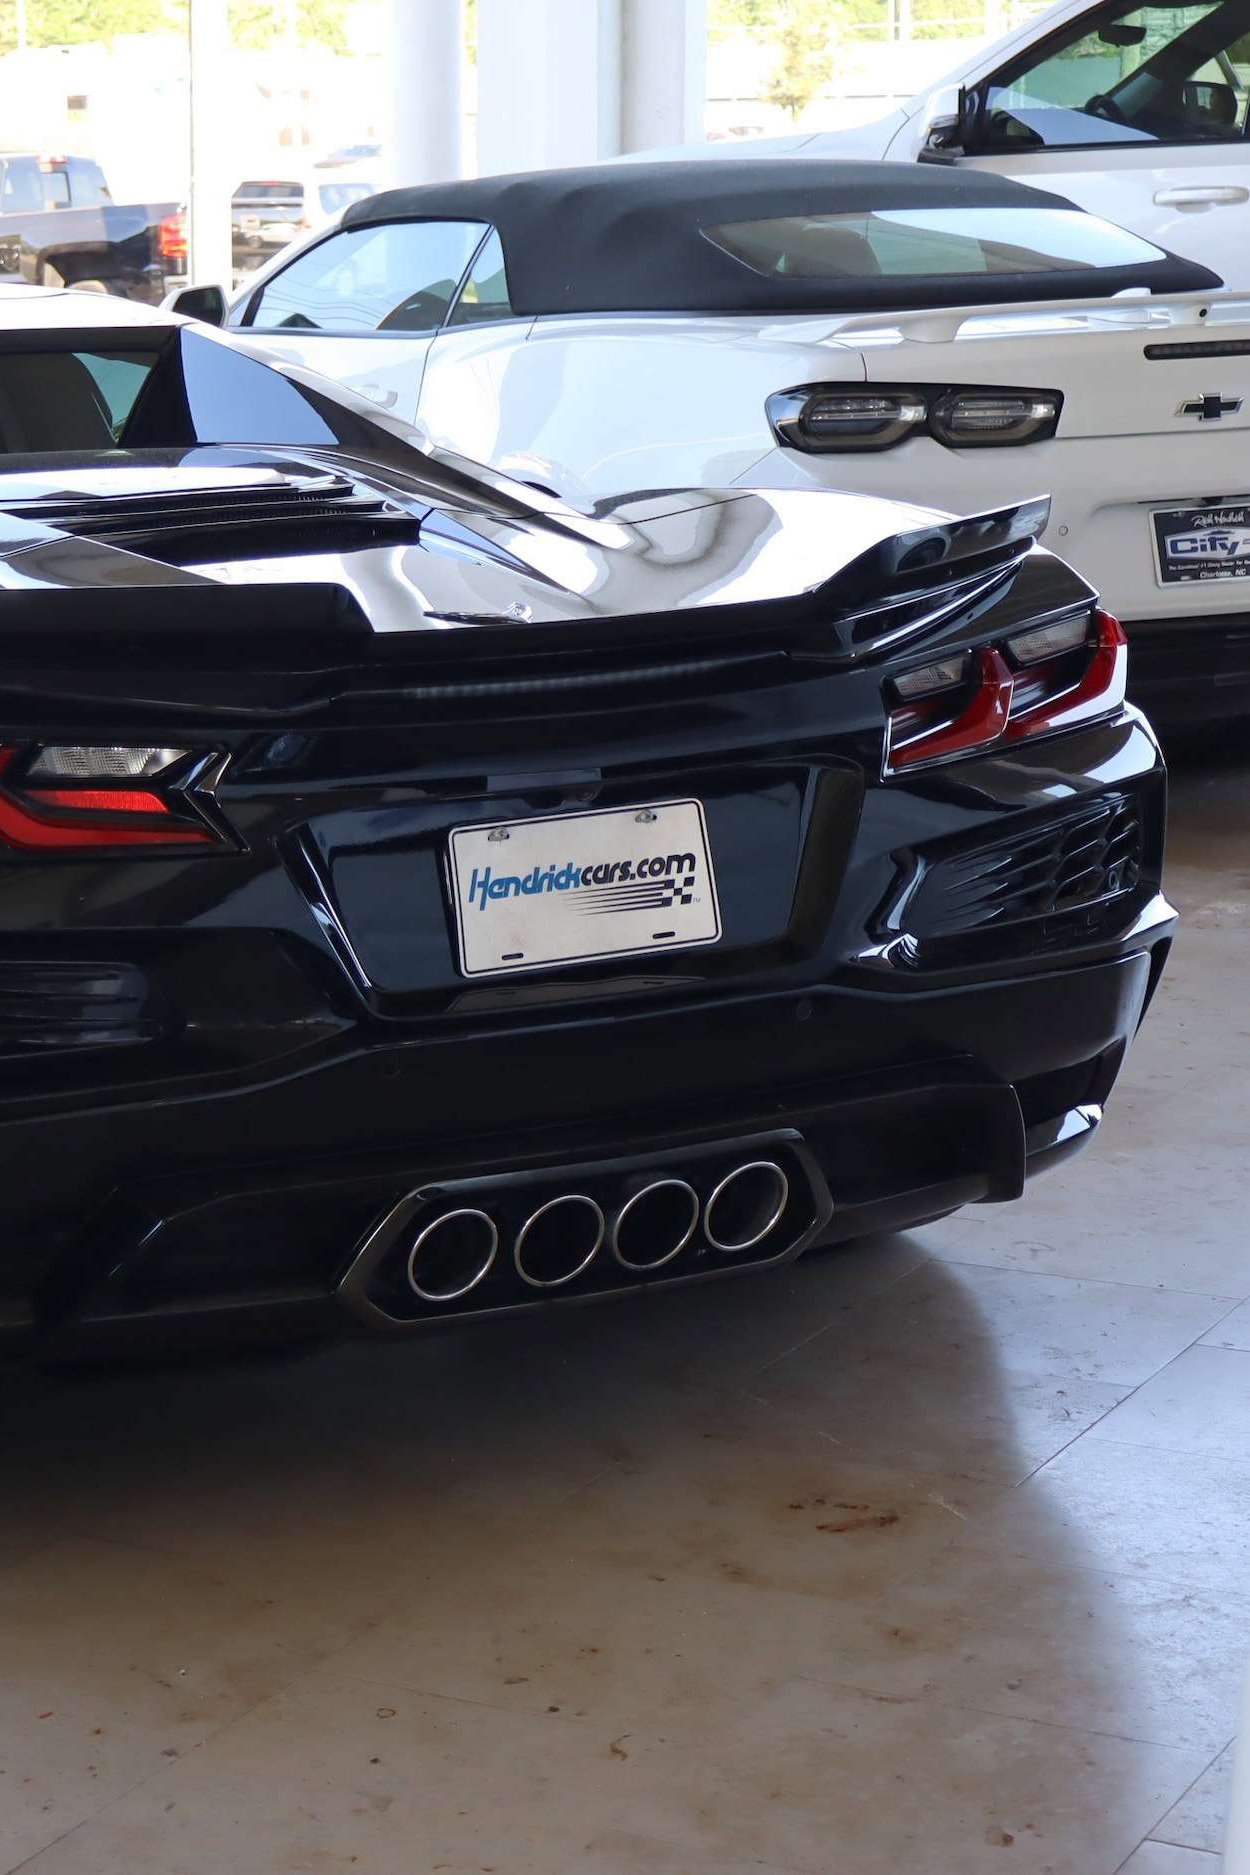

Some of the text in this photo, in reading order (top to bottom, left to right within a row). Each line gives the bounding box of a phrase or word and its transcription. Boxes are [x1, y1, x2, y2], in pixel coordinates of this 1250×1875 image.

[1171, 537, 1240, 556] City
[1235, 568, 1247, 576] NC
[468, 852, 696, 911] Hendrickcars.com
